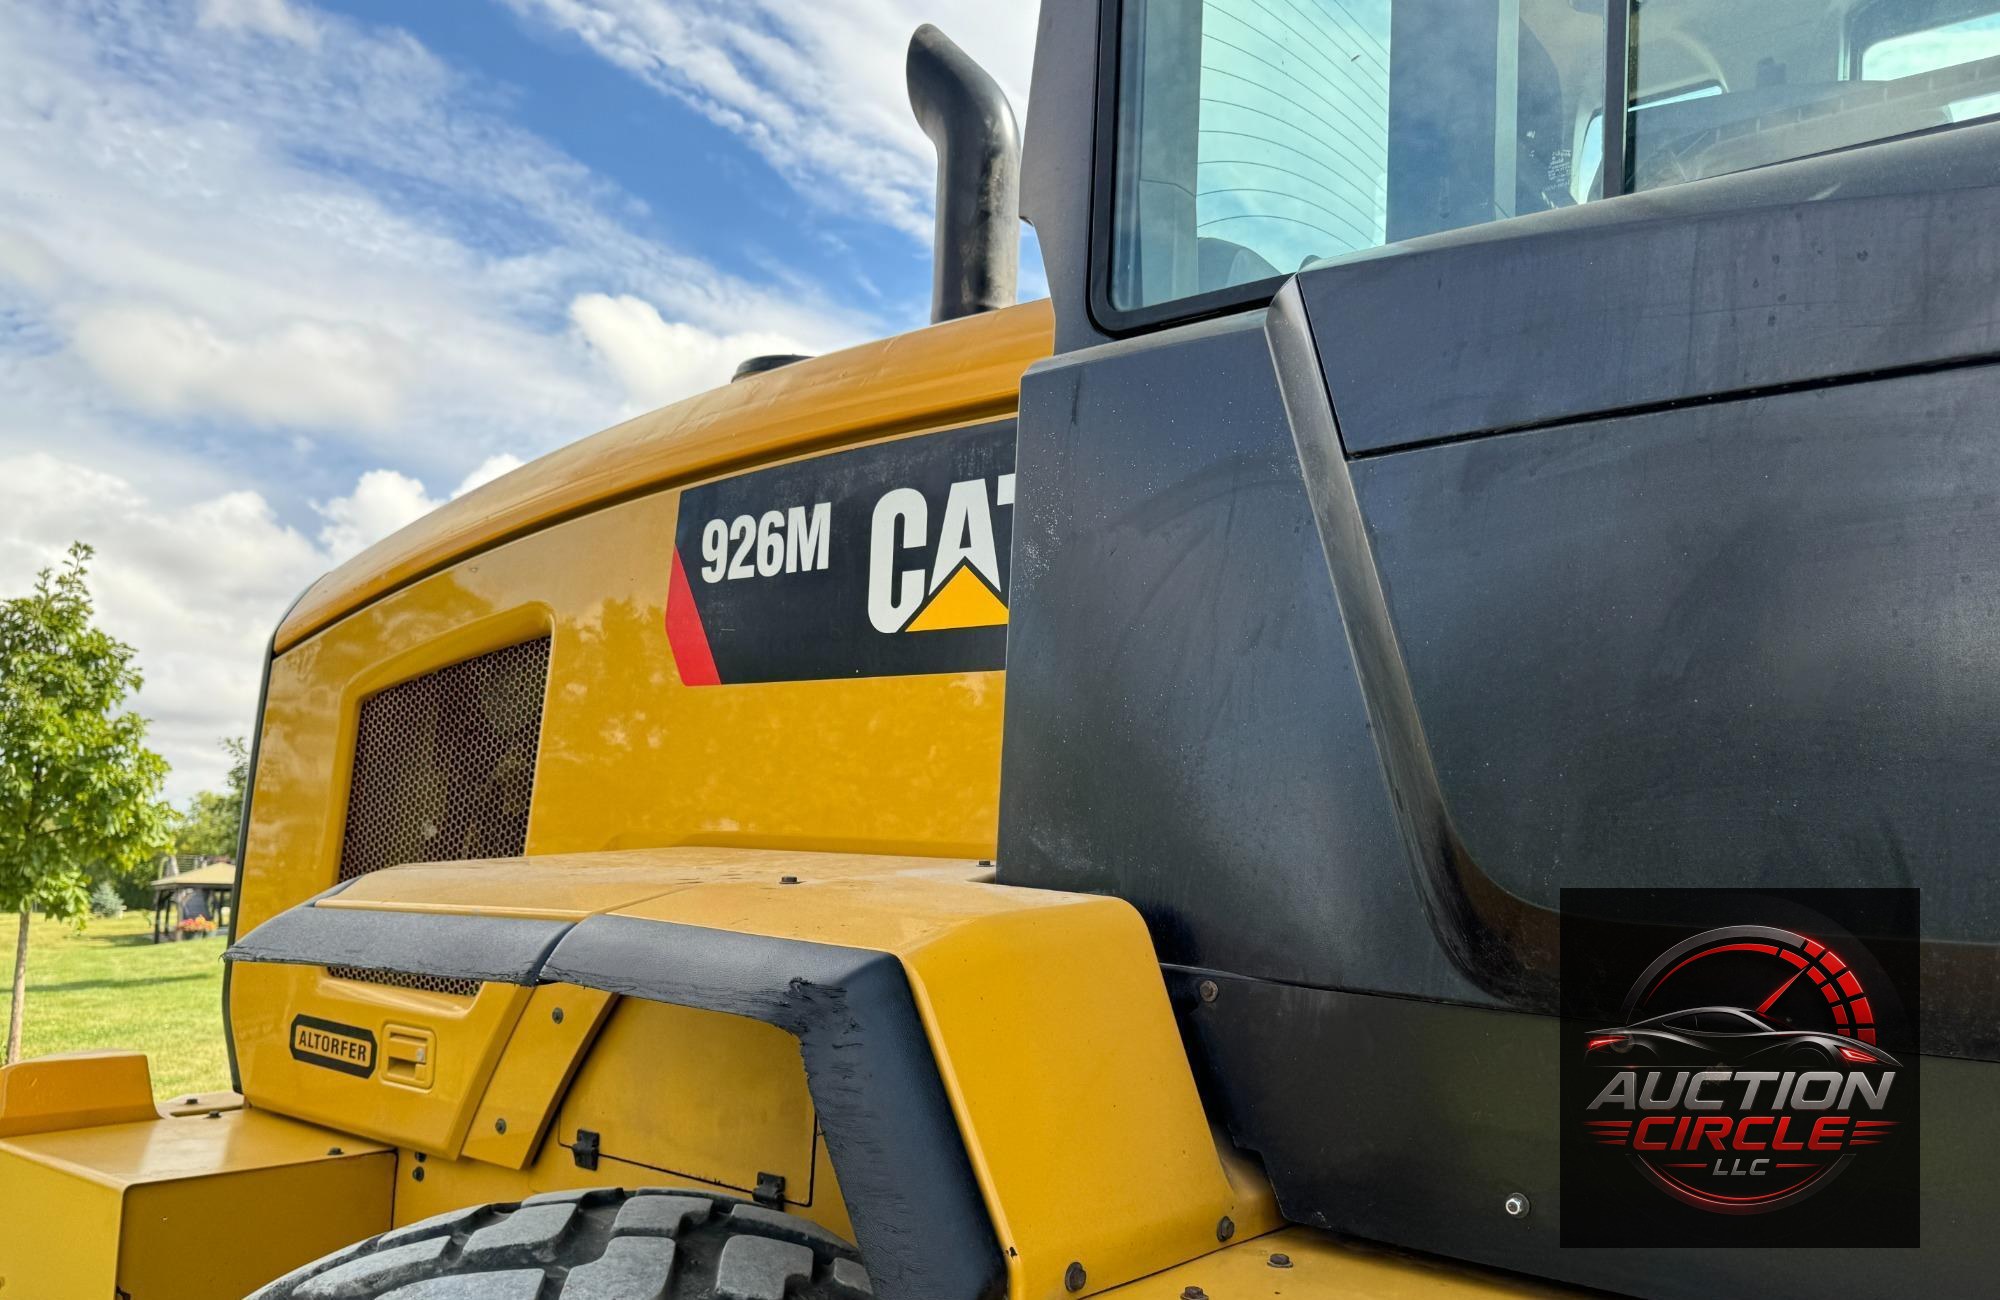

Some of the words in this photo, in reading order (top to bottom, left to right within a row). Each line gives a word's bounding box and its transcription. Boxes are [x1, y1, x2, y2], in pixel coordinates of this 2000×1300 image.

[701, 501, 832, 584] 926M
[868, 473, 1016, 634] CA
[298, 1030, 367, 1062] ALTORFER
